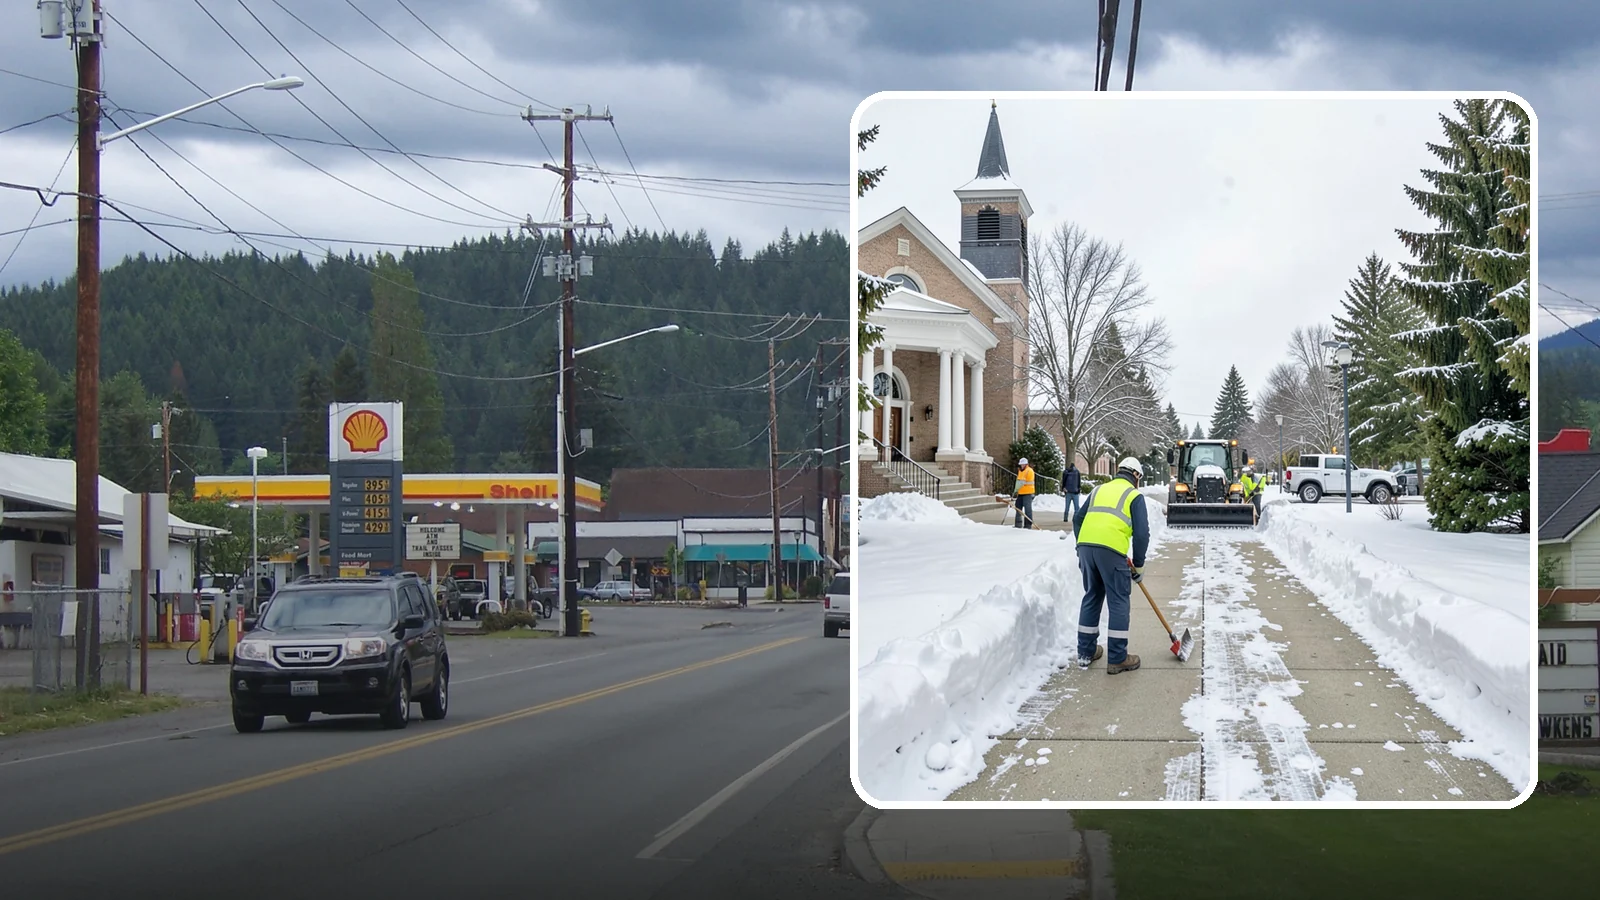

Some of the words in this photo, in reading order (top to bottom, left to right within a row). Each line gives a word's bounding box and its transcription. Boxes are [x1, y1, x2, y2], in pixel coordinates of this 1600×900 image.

[365, 480, 383, 490] 395
[490, 484, 547, 499] Shell
[365, 494, 383, 504] 405
[365, 508, 383, 518] 415
[365, 522, 383, 532] 429
